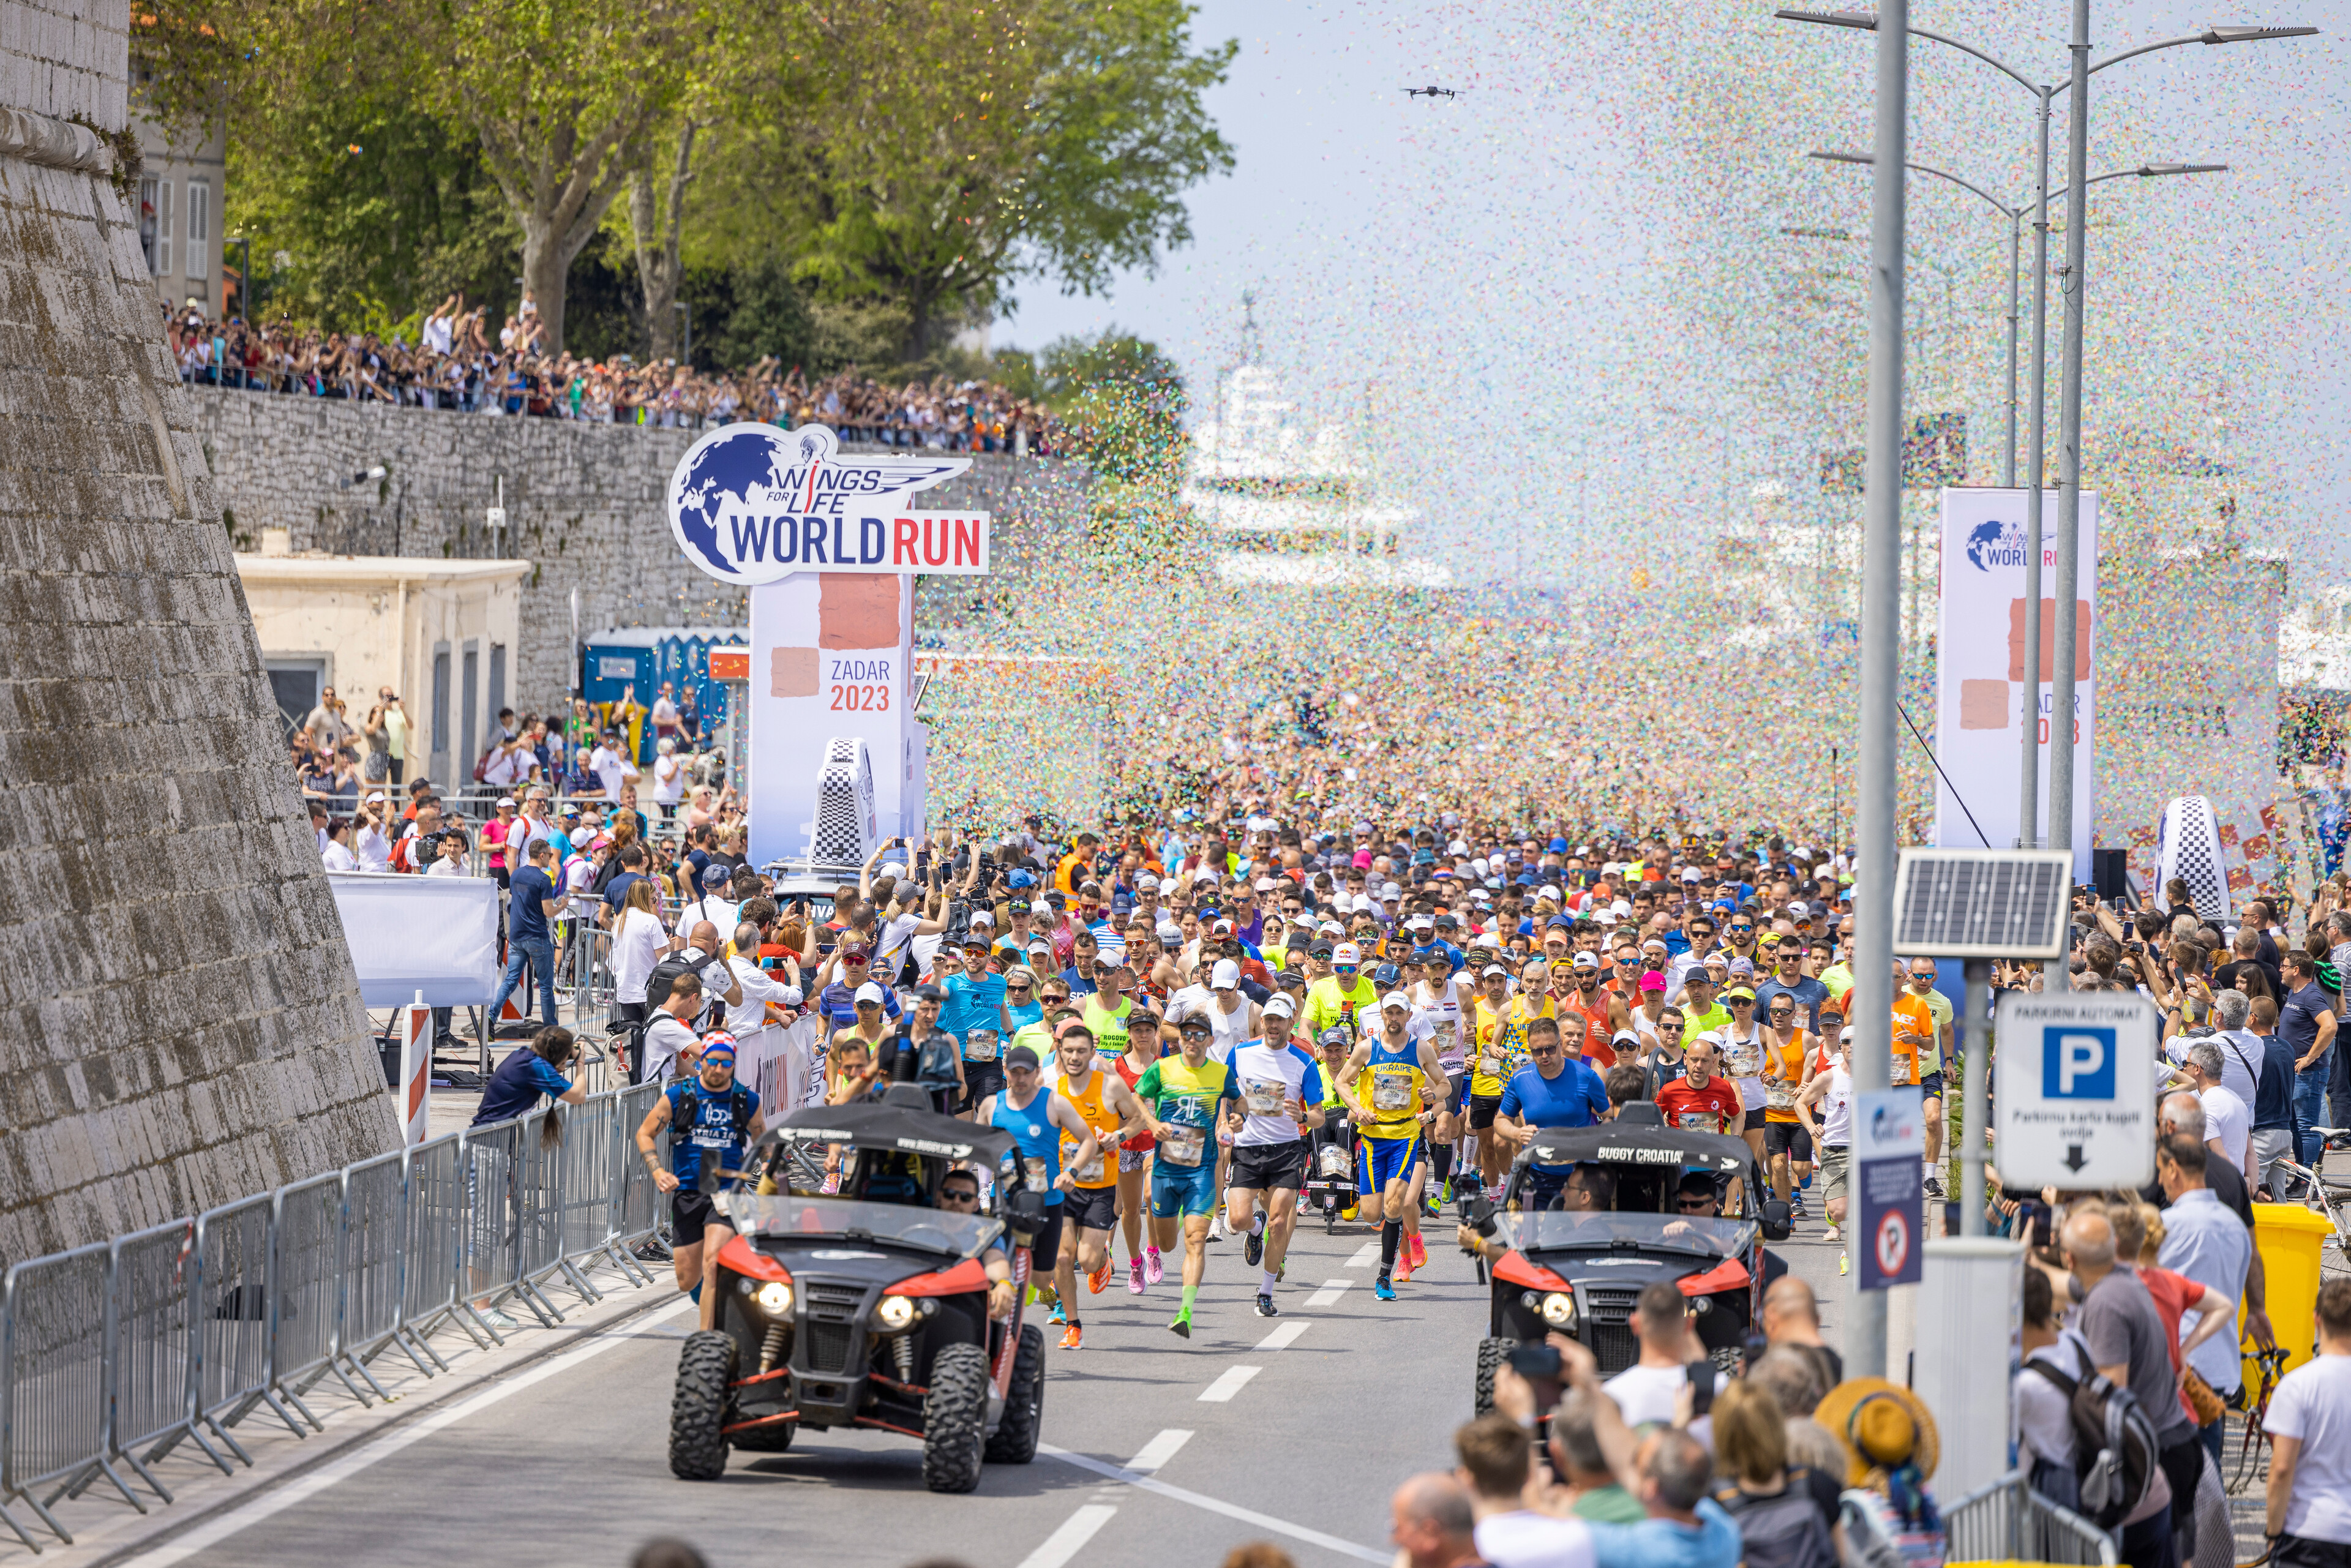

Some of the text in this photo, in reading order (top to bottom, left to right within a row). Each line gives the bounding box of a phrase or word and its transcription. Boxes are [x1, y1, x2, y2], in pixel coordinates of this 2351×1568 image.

[774, 460, 882, 490] WINGS
[766, 491, 850, 514] FOR LIFE
[729, 516, 980, 567] WORLD RUN
[1987, 549, 2028, 566] WORL
[831, 661, 890, 681] ZADAR
[831, 685, 890, 711] 2023
[1891, 1011, 1917, 1026] OMEC
[2059, 1034, 2104, 1094] P
[1597, 1146, 1635, 1160] BUGGY
